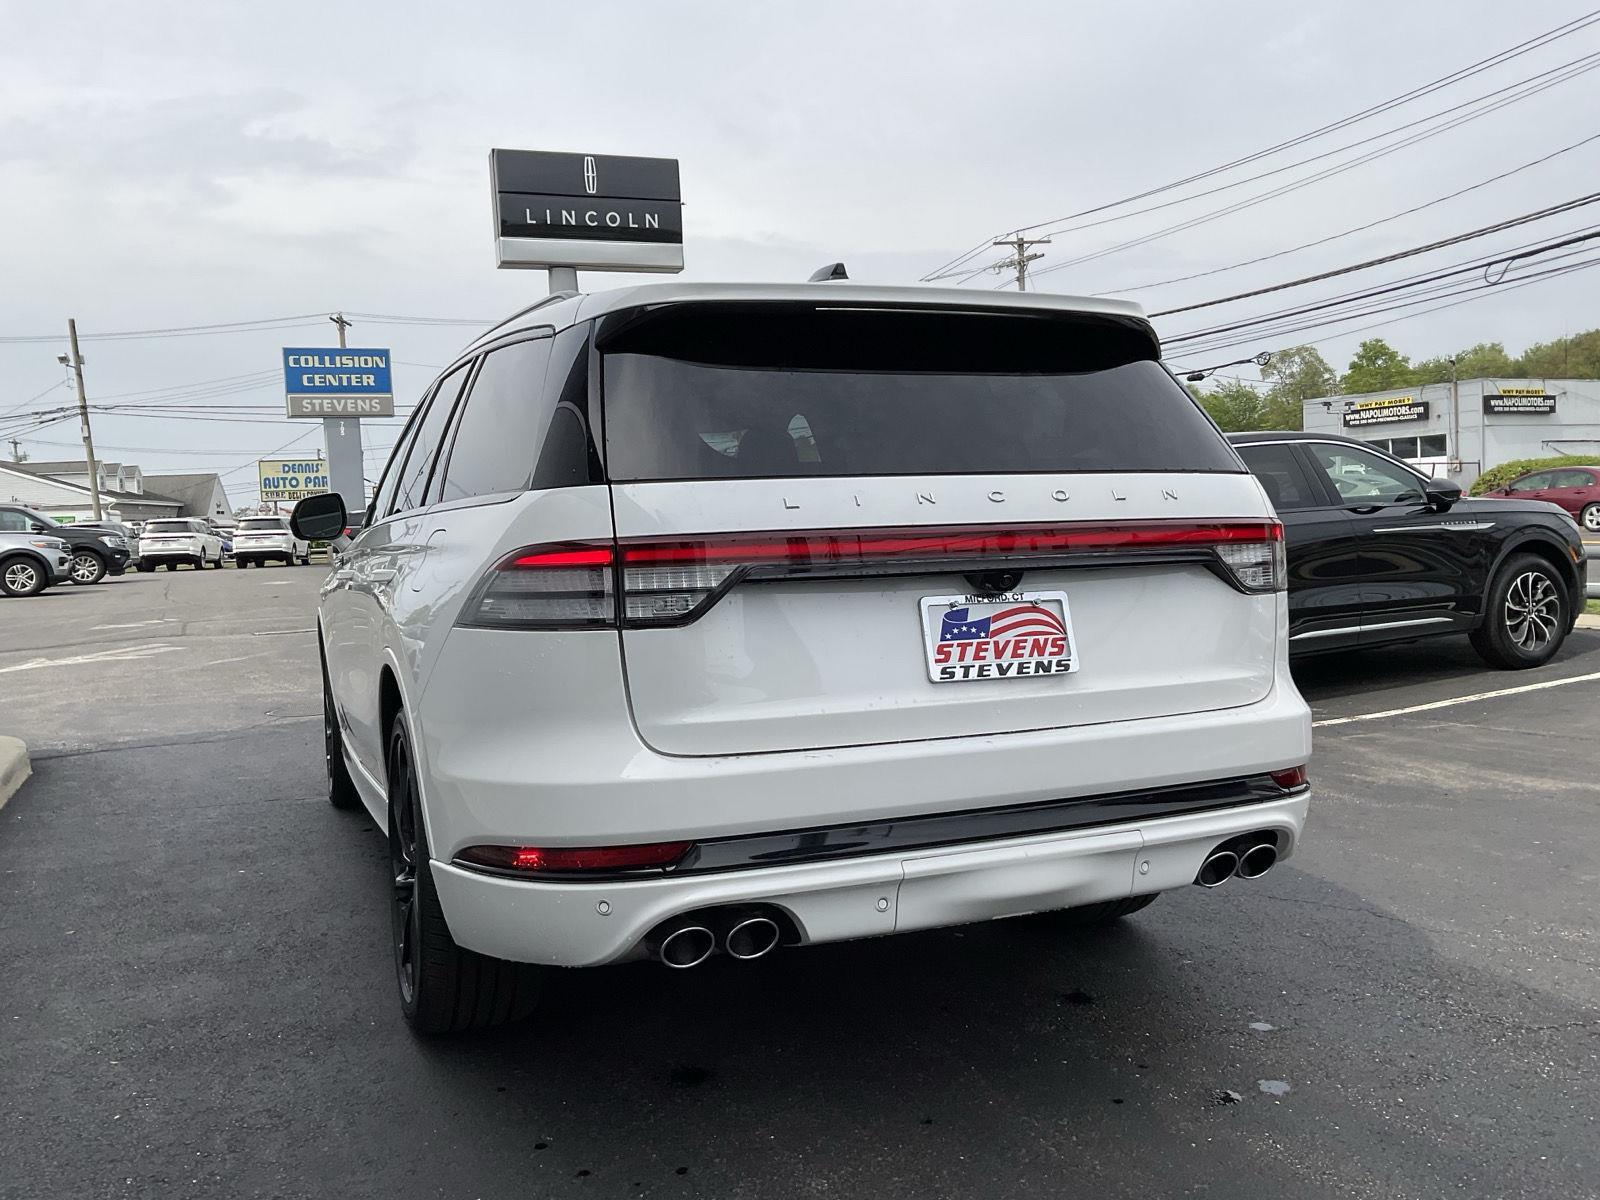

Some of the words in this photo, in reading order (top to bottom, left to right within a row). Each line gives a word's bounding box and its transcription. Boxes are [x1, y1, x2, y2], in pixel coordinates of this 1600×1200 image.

[526, 208, 659, 229] LINCOLN
[288, 355, 386, 368] COLLISION
[302, 374, 375, 386] CENTER
[302, 399, 381, 412] STEVENS
[1345, 405, 1424, 421] www.NAPOLIMOTORS.com
[282, 463, 323, 474] DENNIS'
[263, 476, 300, 489] AUTO
[783, 488, 1179, 510] LINCOLN
[1012, 592, 1024, 601] CT
[934, 636, 1067, 664] STEVENS
[939, 658, 1072, 681] STEVENS
